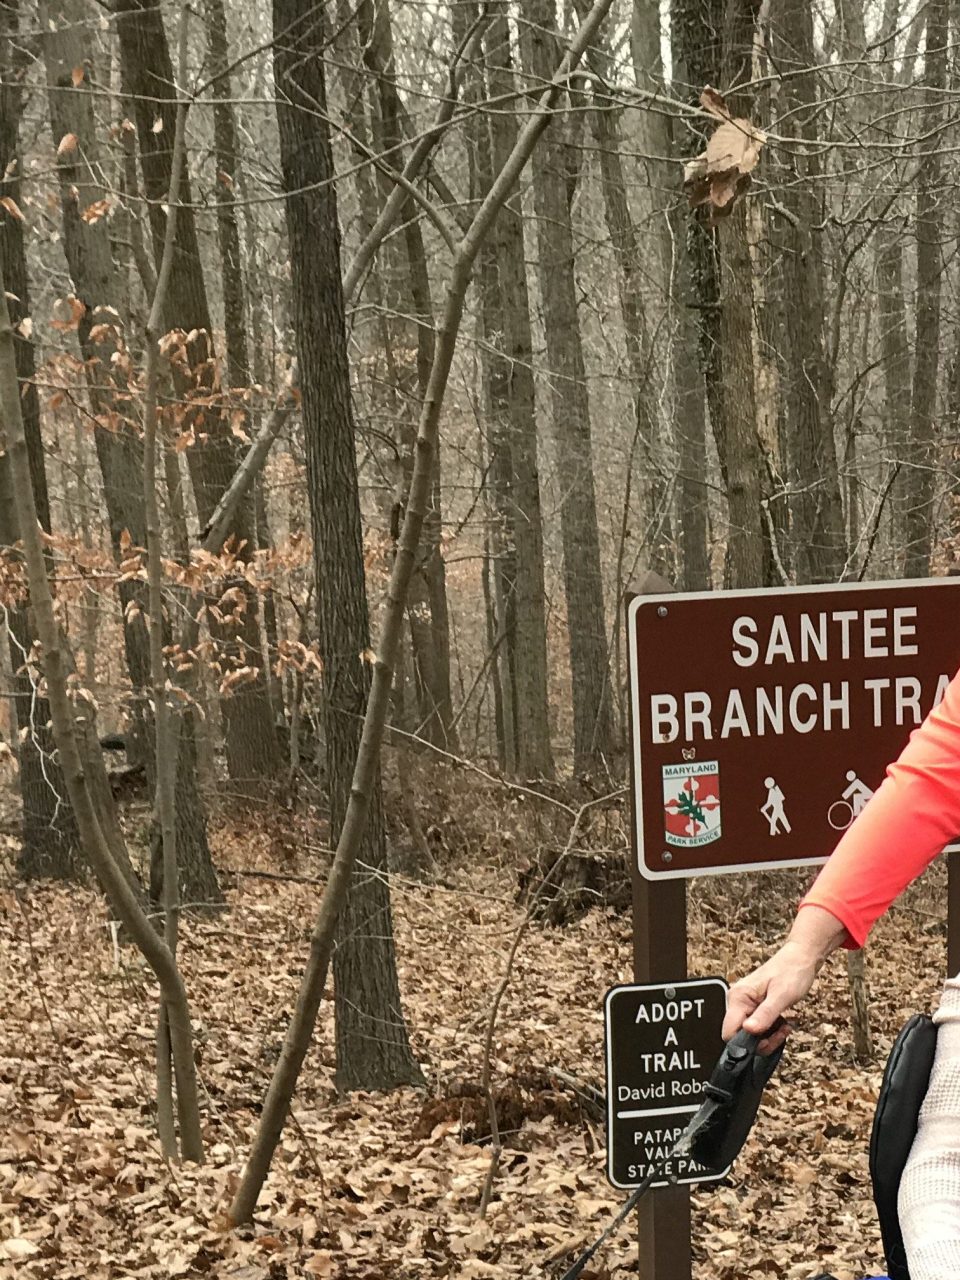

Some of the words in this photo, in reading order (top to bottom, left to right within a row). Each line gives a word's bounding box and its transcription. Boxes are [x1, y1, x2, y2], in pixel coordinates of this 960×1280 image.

[731, 606, 919, 668] SANTEE
[650, 680, 851, 745] BRANCH
[664, 763, 717, 776] MARYLAND
[667, 835, 687, 846] PARK
[689, 831, 719, 845] SERVICE
[635, 998, 705, 1024] ADOPT
[664, 1026, 679, 1047] A
[640, 1049, 701, 1074] TRAIL
[617, 1081, 665, 1102] David
